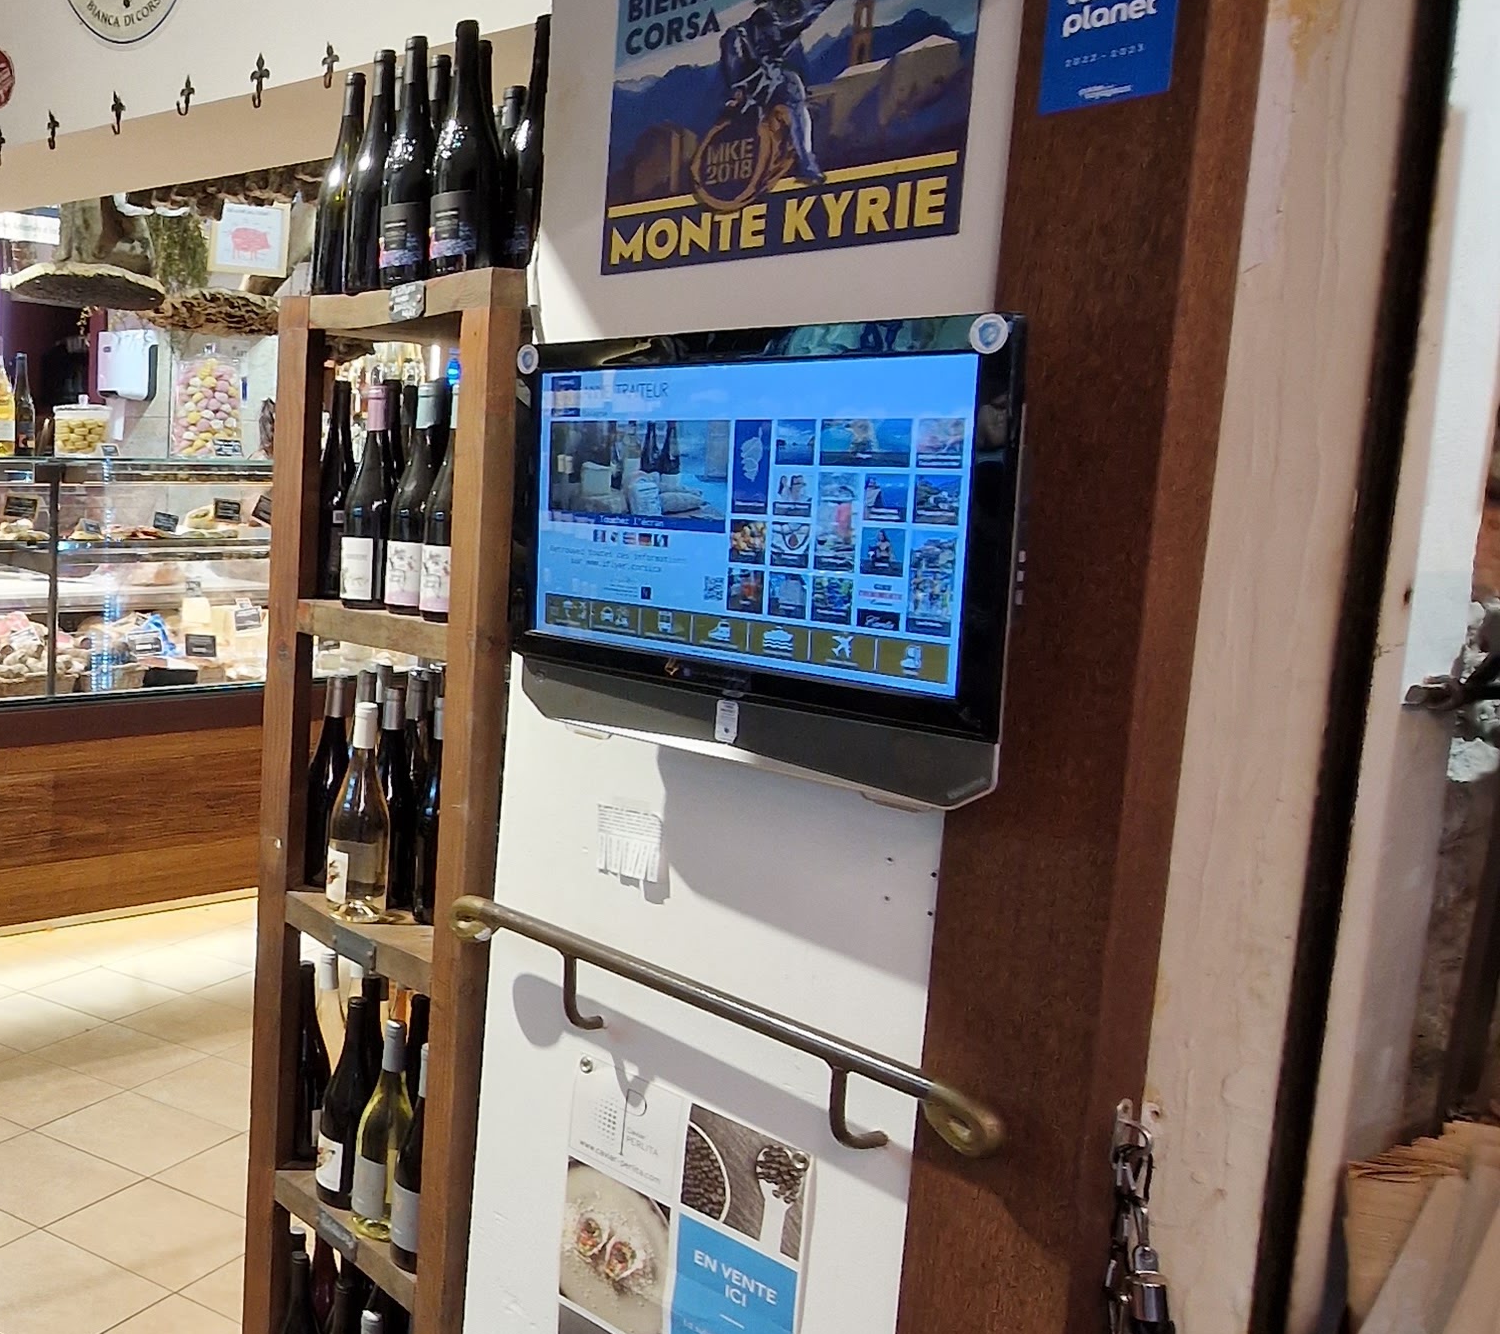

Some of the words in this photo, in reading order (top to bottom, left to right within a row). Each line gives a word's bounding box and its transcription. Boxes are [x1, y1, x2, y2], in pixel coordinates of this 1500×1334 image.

[86, 0, 121, 28] BIANCA
[624, 7, 722, 56] CORSA
[707, 137, 755, 165] MIKE
[705, 159, 753, 185] 2018
[608, 202, 768, 265] MONTE
[781, 176, 949, 244] KYRIE
[626, 1136, 659, 1156] PERLITA
[693, 1250, 718, 1274] EN
[721, 1263, 778, 1306] VENTE
[724, 1284, 748, 1308] ICI
